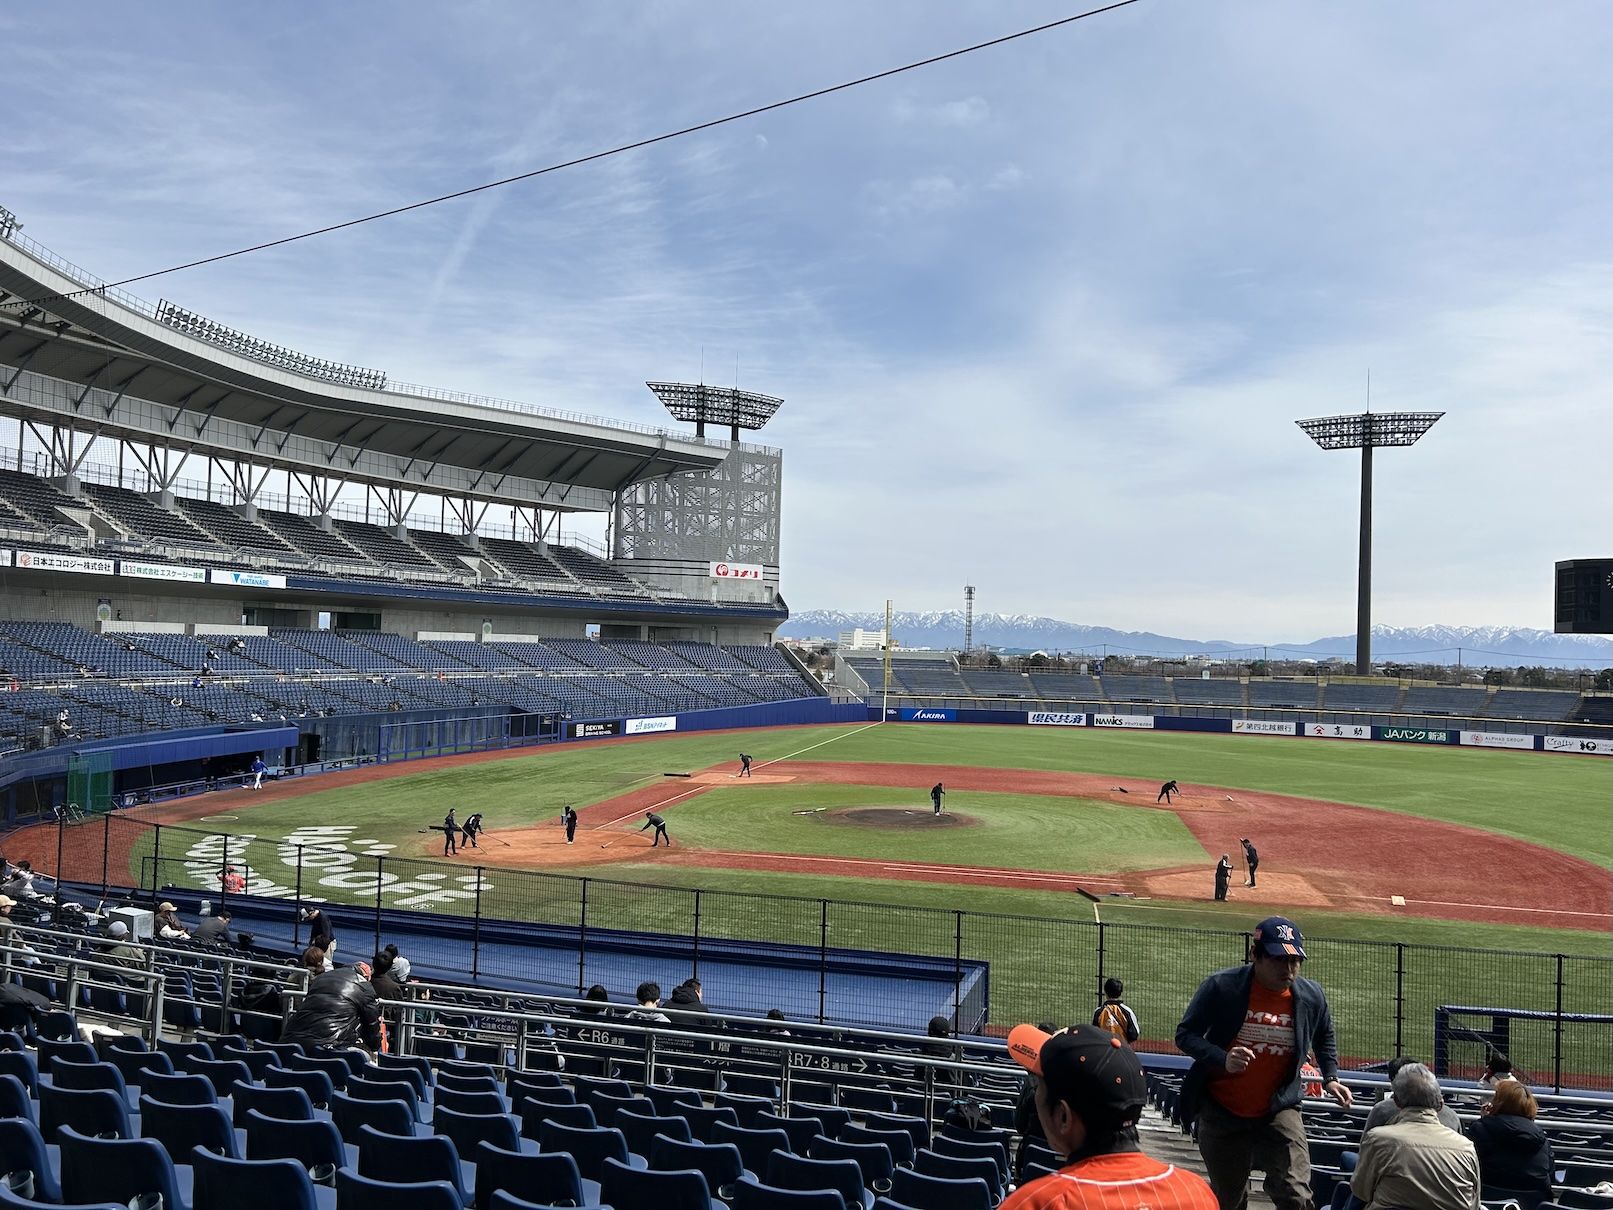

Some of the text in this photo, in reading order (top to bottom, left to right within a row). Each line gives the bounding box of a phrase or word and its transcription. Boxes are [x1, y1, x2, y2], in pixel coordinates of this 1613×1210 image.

[33, 556, 111, 572] 日本エコロジー株式会社
[240, 578, 270, 587] WATANABE
[1032, 713, 1085, 724] 県民共済
[1246, 722, 1292, 733] 第四北越銀行
[1384, 728, 1426, 741] JAバンク
[592, 1030, 610, 1044] R6
